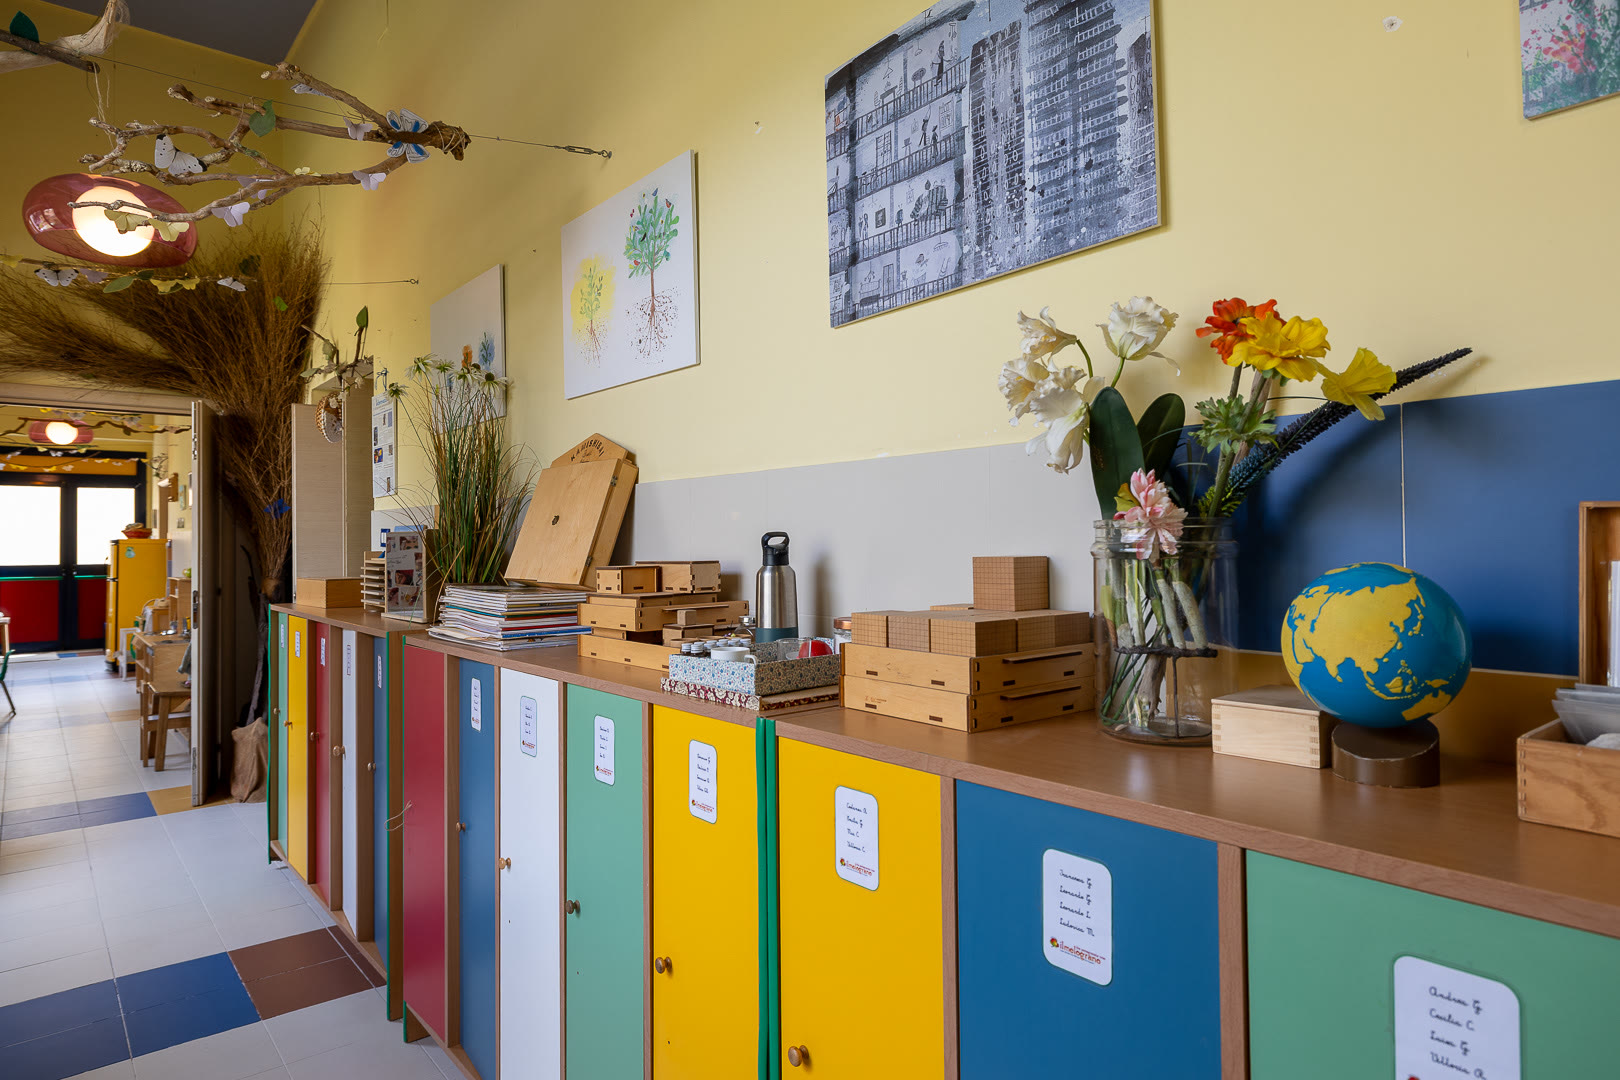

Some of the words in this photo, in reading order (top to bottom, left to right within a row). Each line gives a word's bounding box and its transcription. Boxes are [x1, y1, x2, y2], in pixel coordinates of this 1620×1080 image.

[1059, 885, 1085, 900] Leonardo
[1059, 901, 1085, 917] Leonardo
[1060, 940, 1102, 965] ilmelograno
[1429, 986, 1468, 1006] Andrea
